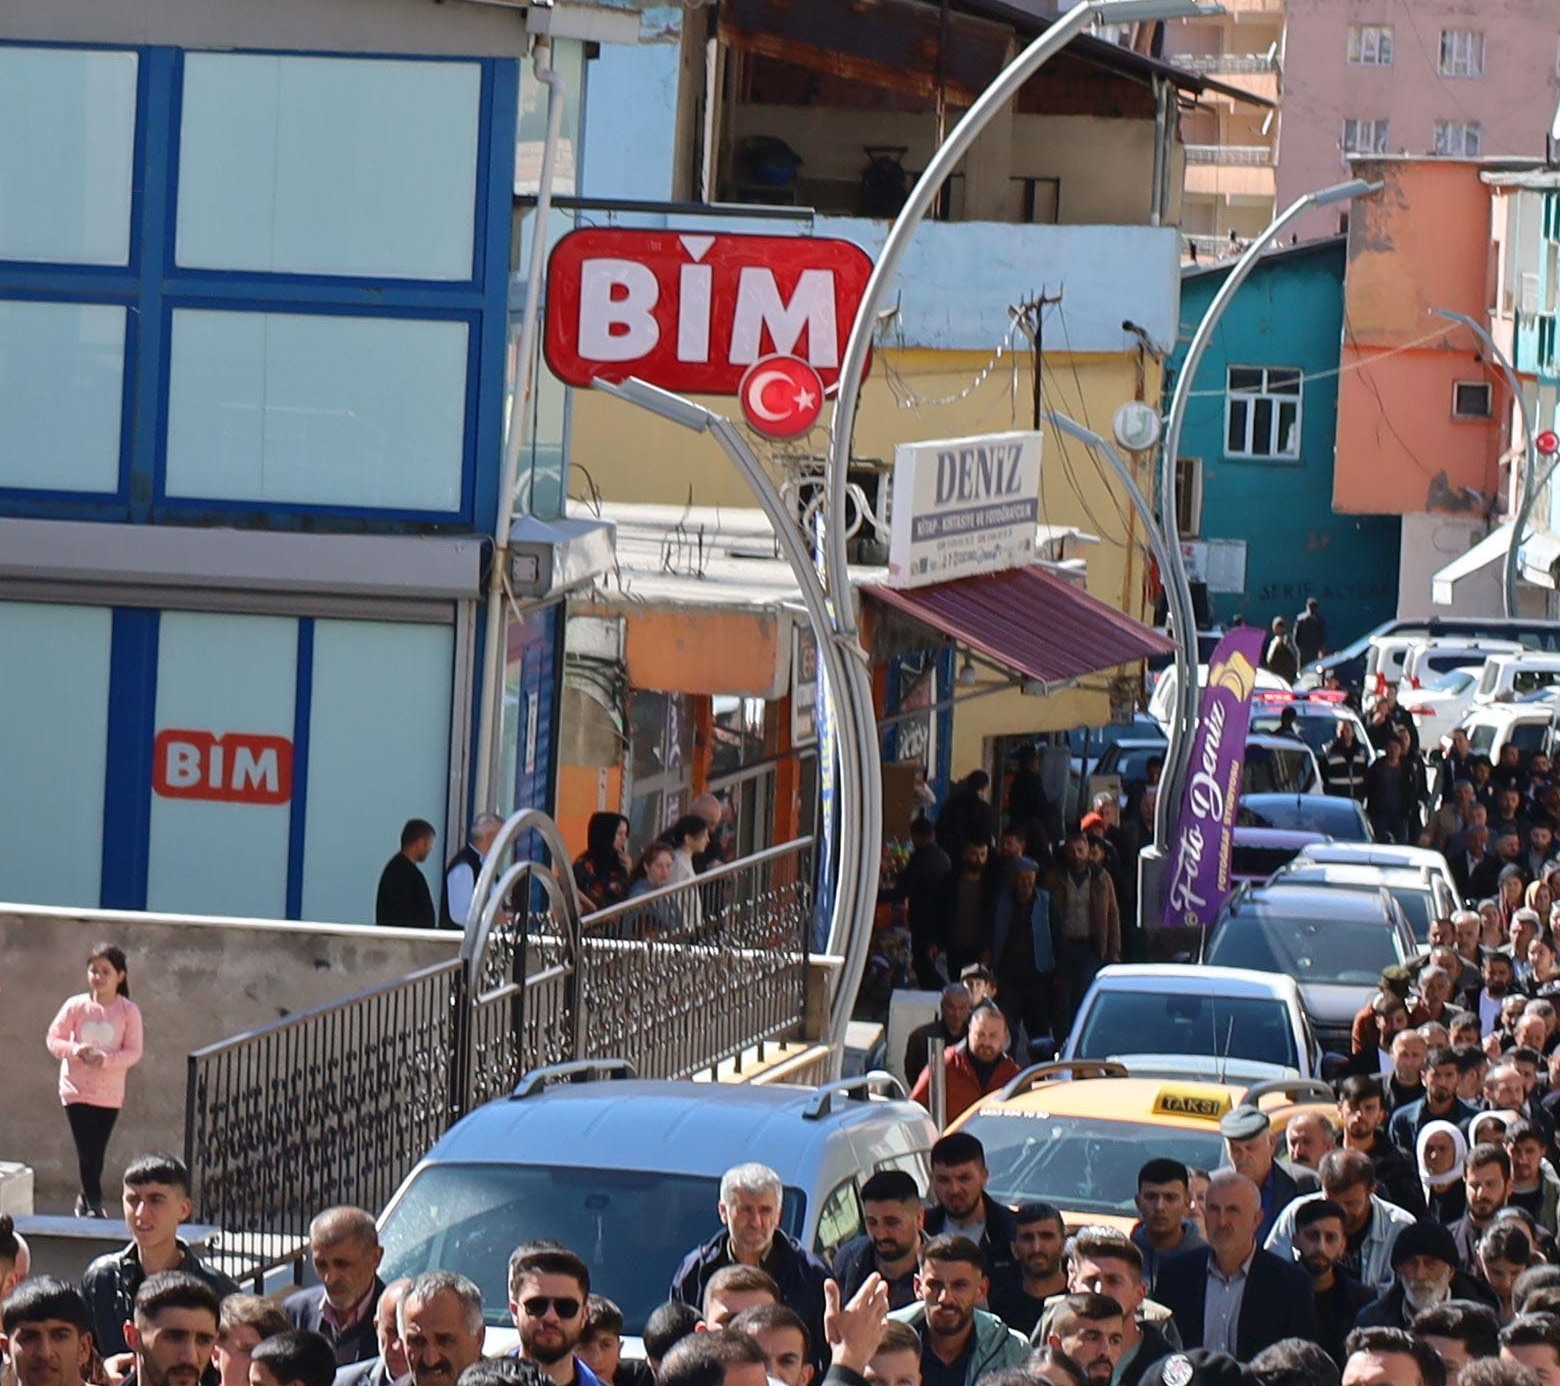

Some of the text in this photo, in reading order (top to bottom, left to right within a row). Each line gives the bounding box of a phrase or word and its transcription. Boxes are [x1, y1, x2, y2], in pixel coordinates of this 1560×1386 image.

[578, 234, 839, 368] BİM
[935, 442, 1023, 505] DENİZ
[1170, 698, 1225, 912] Foto Deniz
